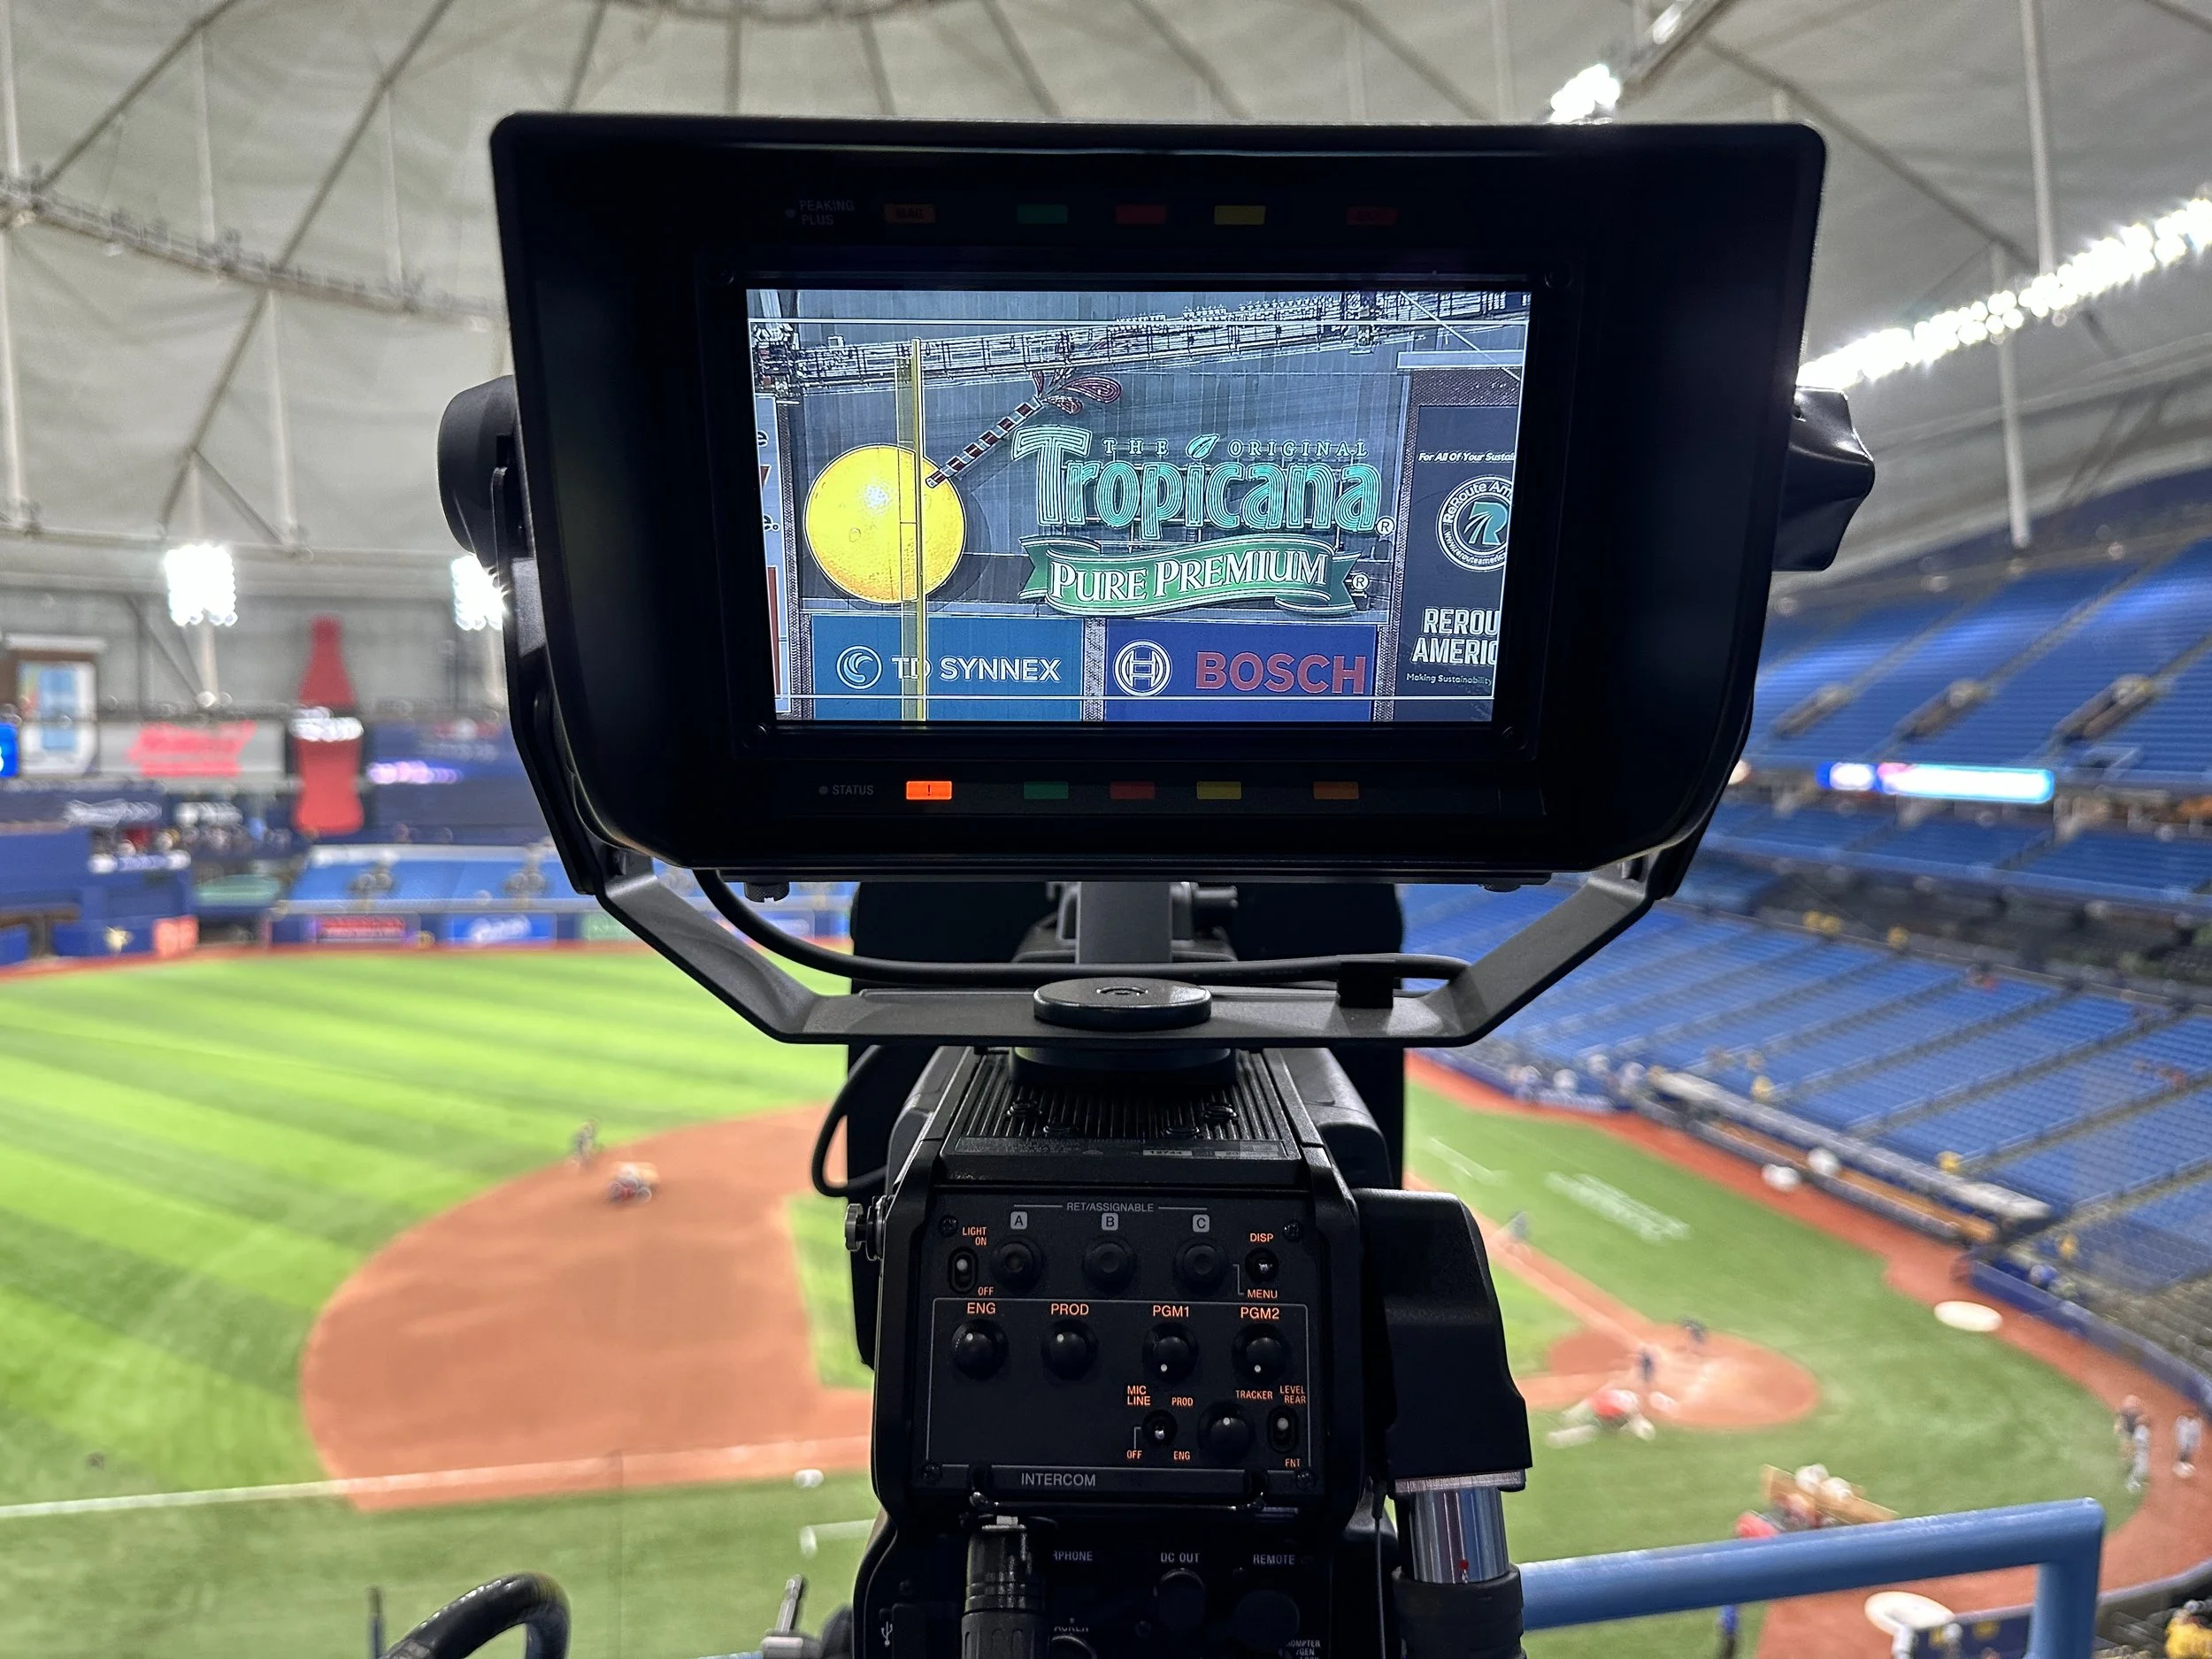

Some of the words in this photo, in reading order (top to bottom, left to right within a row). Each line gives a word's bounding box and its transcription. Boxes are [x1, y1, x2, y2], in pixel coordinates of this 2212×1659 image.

[798, 199, 855, 211] PEAKING
[801, 214, 834, 226] PLUS
[1103, 439, 1169, 456] THE
[1229, 439, 1369, 457] ORIGINAL
[1418, 452, 1434, 461] For
[1434, 452, 1448, 461] All
[1449, 452, 1462, 461] Of
[1463, 452, 1486, 461] Your
[1011, 425, 1382, 540] Tropicana
[1442, 482, 1488, 524] ReRoute
[1050, 560, 1148, 602] PURE
[1154, 549, 1328, 598] PREMIUM
[890, 657, 932, 680] TD
[940, 657, 1062, 682] SYNNEX
[1195, 650, 1366, 695] BOSCH
[1406, 673, 1436, 684] Making
[1438, 674, 1493, 686] Sustainability
[832, 785, 873, 795] STATUS
[1066, 1202, 1154, 1213] RET/ASSIGNABLE
[1014, 1215, 1024, 1226] A
[1106, 1217, 1115, 1227] B
[1196, 1217, 1206, 1229] C
[962, 1226, 987, 1236] LIGHT
[975, 1237, 987, 1246] ON
[1249, 1233, 1274, 1242] DISP
[978, 1286, 995, 1296] OFF
[1247, 1289, 1278, 1299] MENU
[966, 1302, 996, 1315] ENG
[1050, 1303, 1089, 1316] PROD
[1153, 1305, 1190, 1317] PGM1
[1240, 1307, 1279, 1320] PGM2
[1126, 1386, 1147, 1395] MIC
[1235, 1390, 1273, 1400] TRACKER
[1279, 1386, 1306, 1395] LEVEL
[1126, 1395, 1150, 1406] LINE
[1171, 1397, 1194, 1407] PROD
[1284, 1394, 1306, 1404] REAR
[1126, 1450, 1142, 1460] OFF
[1173, 1451, 1191, 1461] ENG
[1285, 1458, 1301, 1468] FNT
[1021, 1473, 1096, 1486] INTERCOM
[1160, 1552, 1175, 1563] DC
[1179, 1552, 1201, 1563] OUT
[1253, 1554, 1295, 1565] REMOTE
